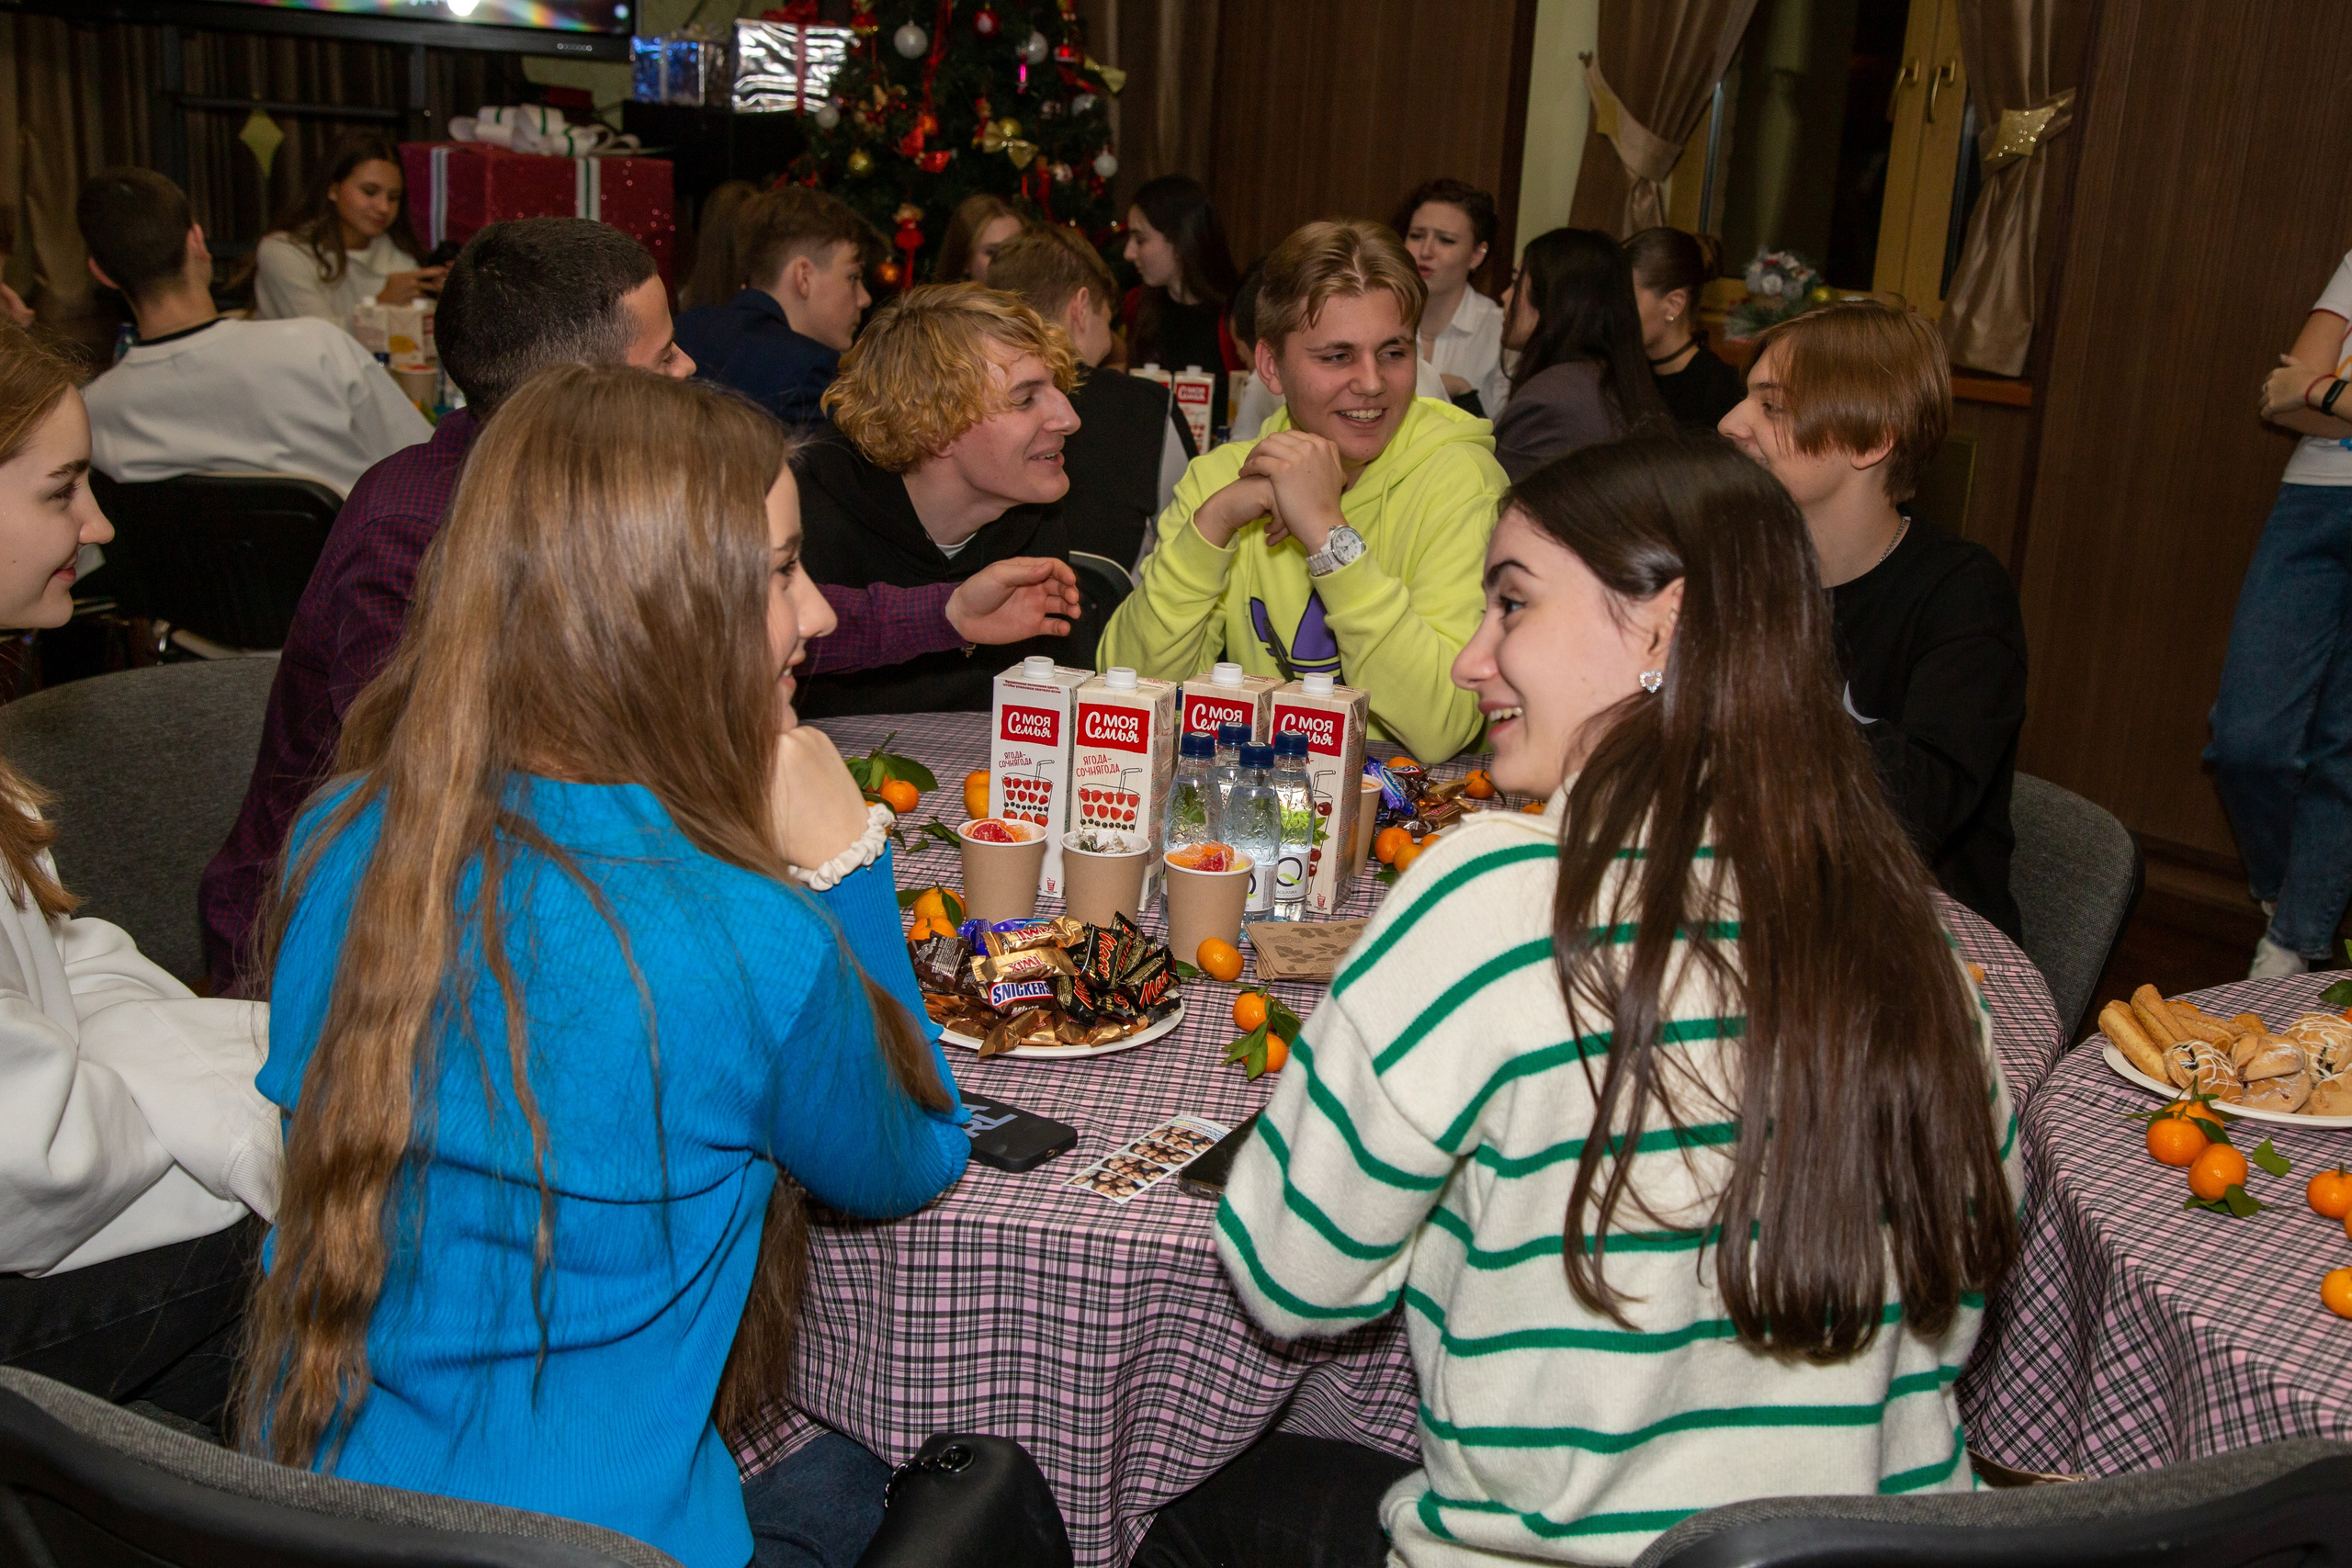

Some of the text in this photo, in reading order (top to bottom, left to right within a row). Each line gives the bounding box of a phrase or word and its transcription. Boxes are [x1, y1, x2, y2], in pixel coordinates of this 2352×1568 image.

[1022, 713, 1051, 728] МОЯ
[1103, 714, 1138, 731] МОЯ
[1191, 703, 1220, 731] Сем
[1208, 705, 1243, 723] МОЯ
[1007, 711, 1052, 738] Семья
[1084, 711, 1140, 744] Семья
[1298, 716, 1334, 734] МОЯ
[1082, 754, 1113, 766] ЯГОДА-
[1076, 763, 1120, 777] СОЧНЯГОДА
